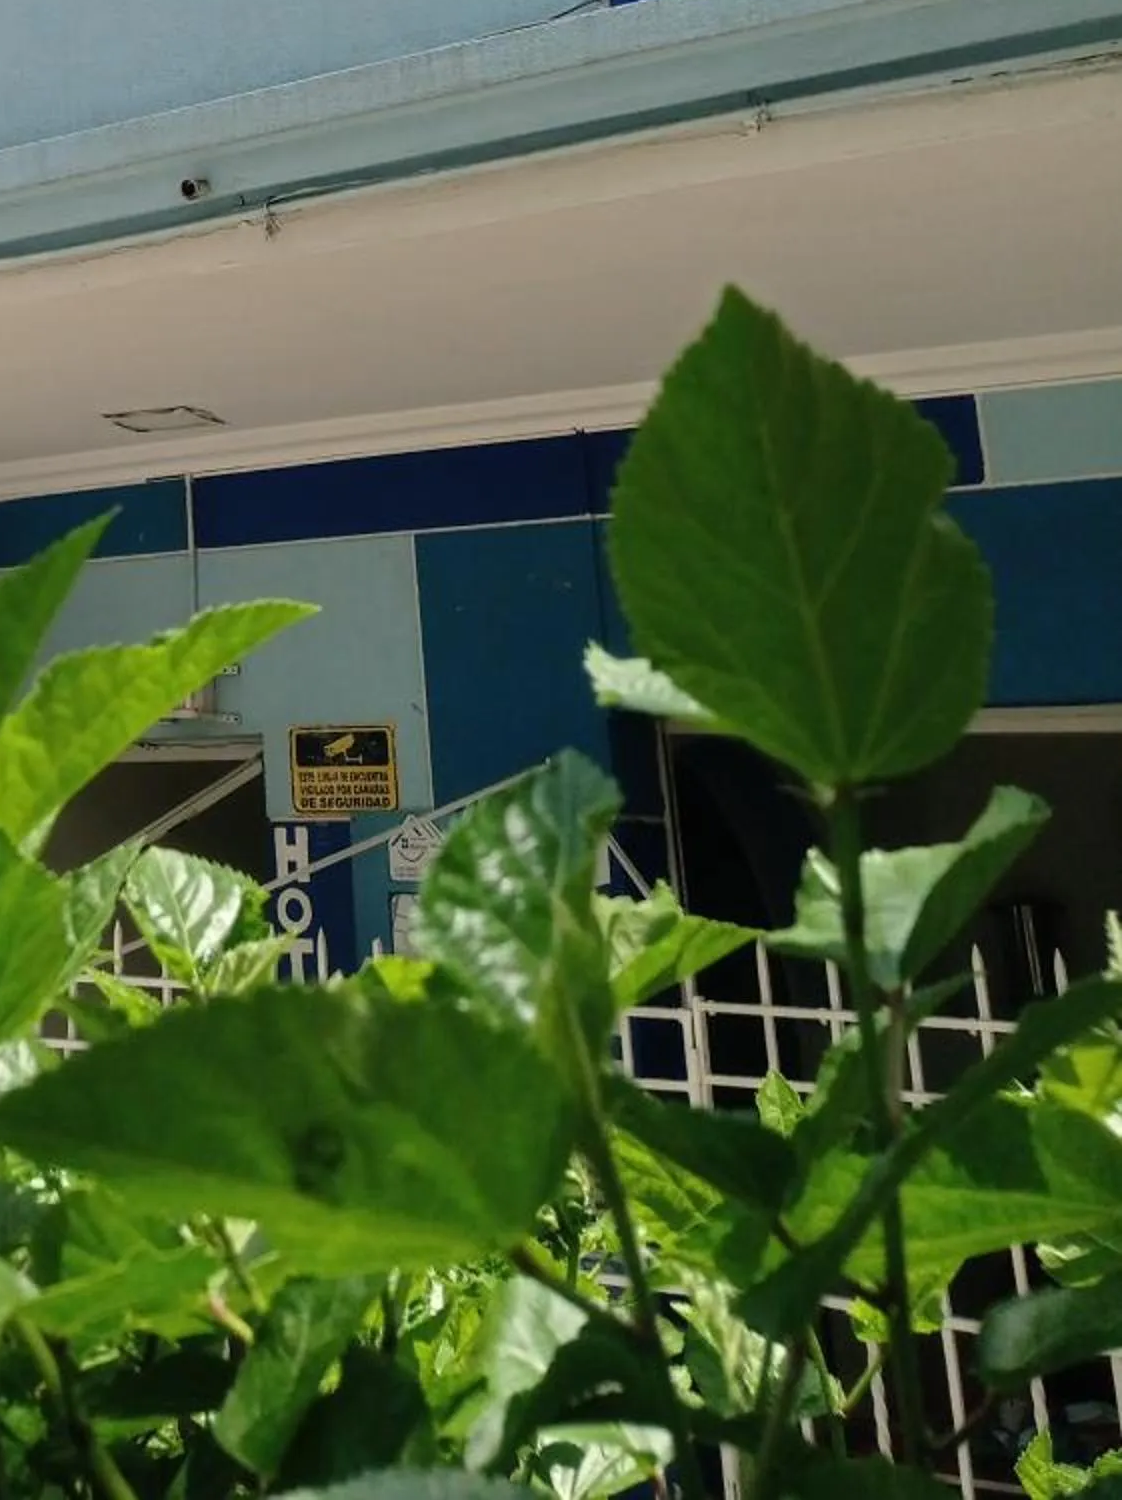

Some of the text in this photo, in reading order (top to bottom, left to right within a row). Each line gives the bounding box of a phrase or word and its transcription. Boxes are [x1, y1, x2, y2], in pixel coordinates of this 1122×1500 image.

[301, 796, 391, 808] DE SEGURIDAD
[274, 827, 315, 985] HOT
